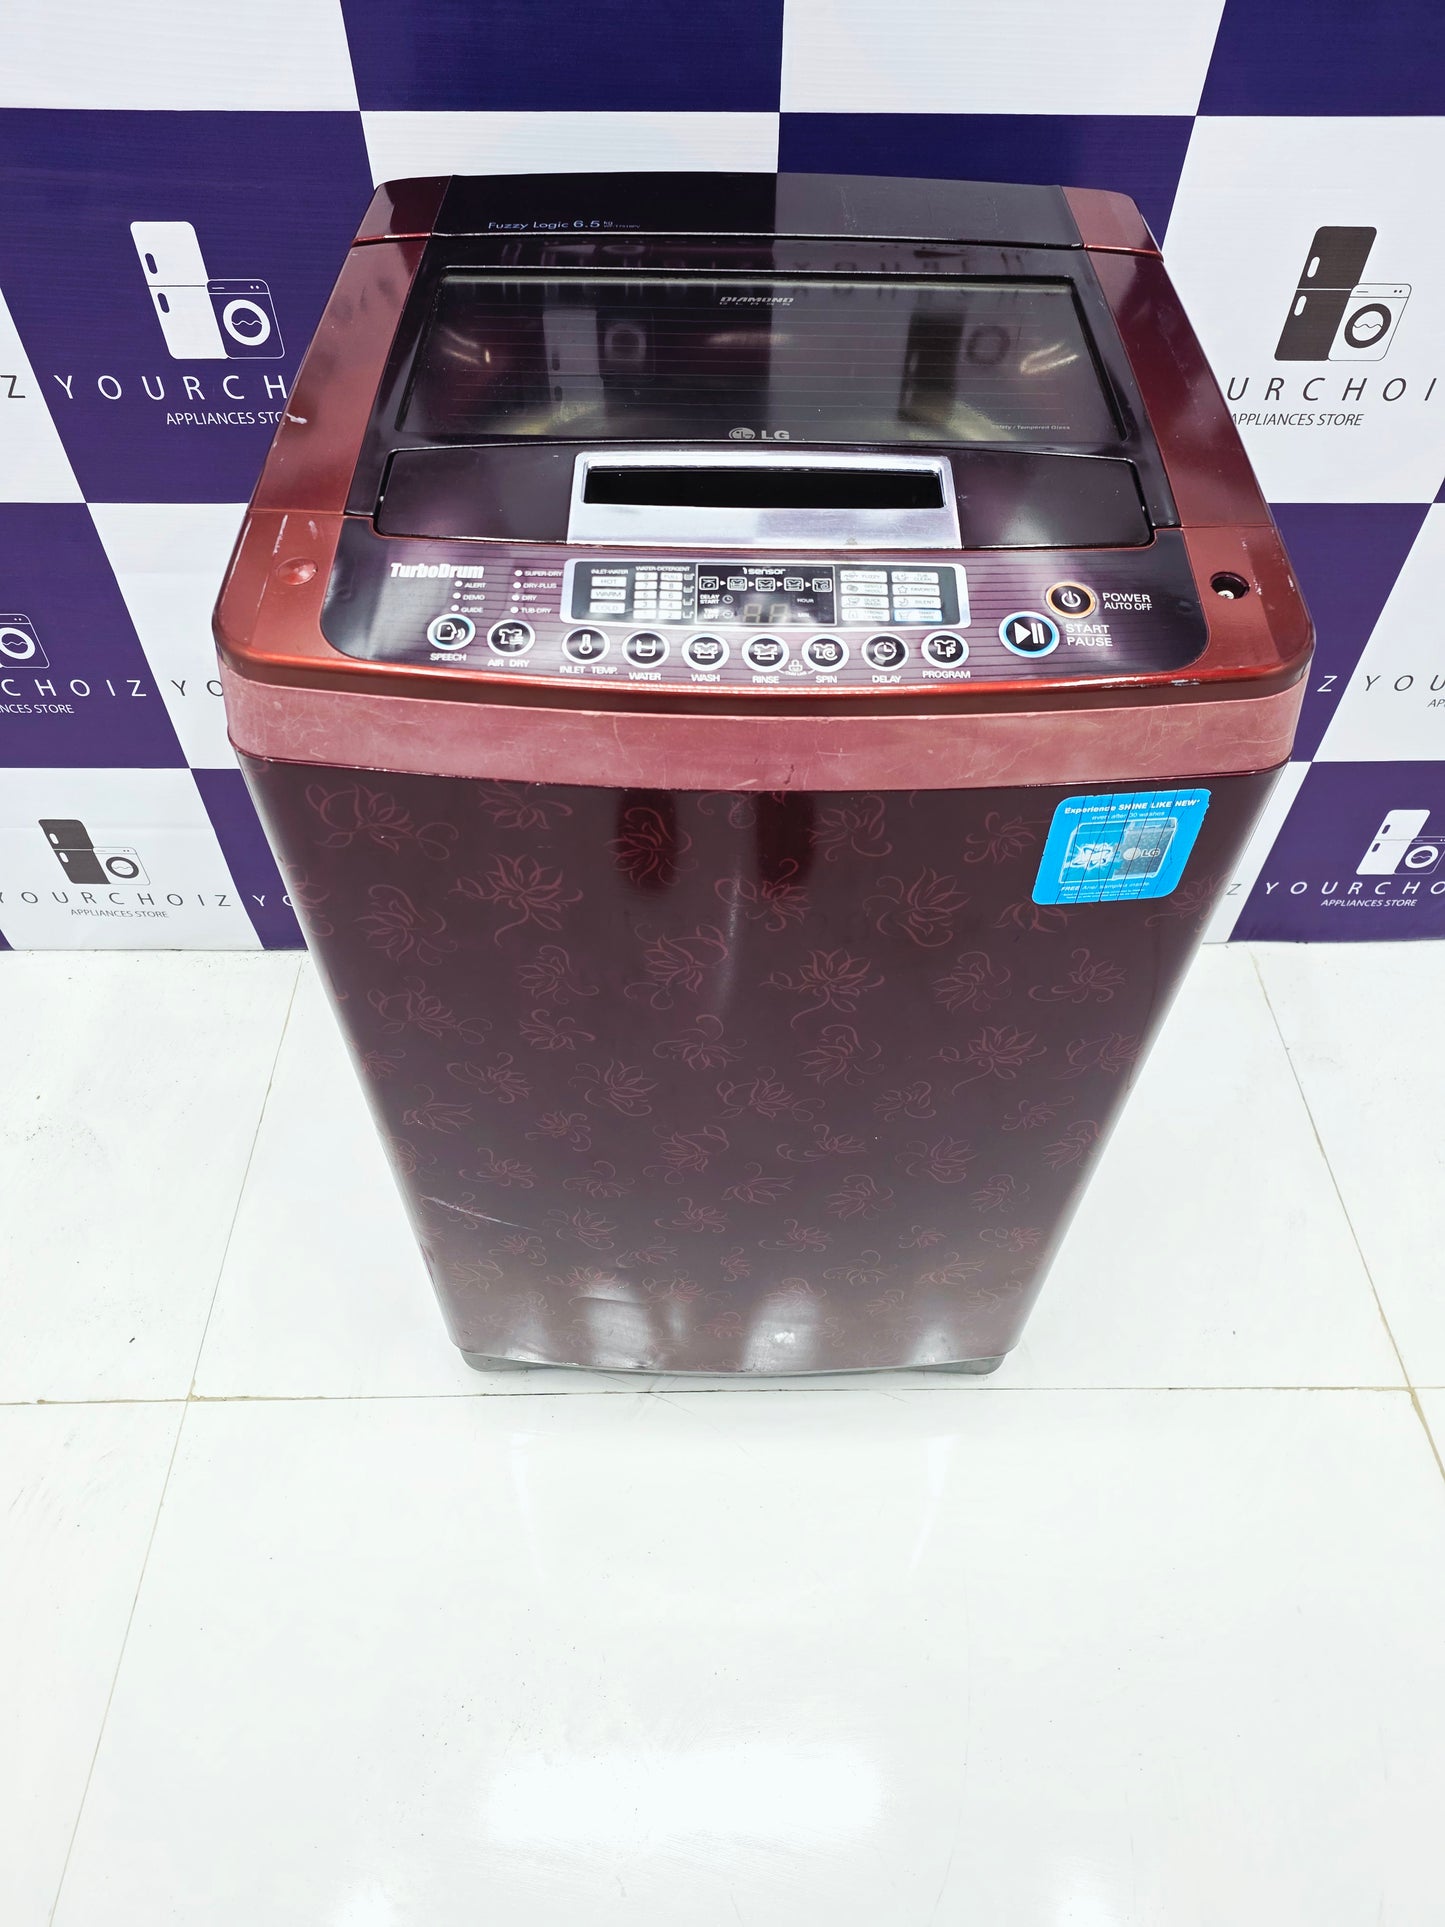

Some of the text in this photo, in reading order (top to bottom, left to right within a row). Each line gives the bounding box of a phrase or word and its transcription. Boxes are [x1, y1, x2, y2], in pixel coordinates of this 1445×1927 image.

[488, 222, 529, 230] Fuzzy
[533, 221, 569, 230] Logic
[573, 220, 601, 228] 6.5
[166, 411, 256, 425] APPLIANCES
[1316, 413, 1365, 426] STORE
[761, 430, 790, 440] LG
[390, 562, 485, 579] TurboDrum
[464, 581, 487, 589] ALERT
[462, 593, 486, 601] DEMO
[1102, 592, 1151, 603] POWER
[461, 606, 484, 614] GUIDE
[521, 606, 552, 614] TUB-DRY
[1104, 601, 1153, 611] AUTO OFF
[1065, 623, 1110, 633] START
[1067, 637, 1113, 647] PAUSE
[430, 653, 467, 662] SPEECH
[488, 658, 530, 668] AIR DRY
[559, 665, 585, 674] INLET
[628, 672, 662, 681] WATER
[690, 674, 721, 683] WASH
[752, 675, 779, 684] RINSE
[815, 675, 837, 684] SPIN
[872, 675, 902, 684] DELAY
[922, 670, 971, 680] PROGRAM
[33, 704, 75, 714] STORE
[1064, 805, 1117, 815] Experience
[1118, 803, 1148, 811] SHINE
[1151, 801, 1173, 809] LIKE
[1141, 848, 1161, 858] LG
[1320, 899, 1418, 907] APPLIANCES STORE
[71, 909, 169, 919] APPLIANCES STORE
